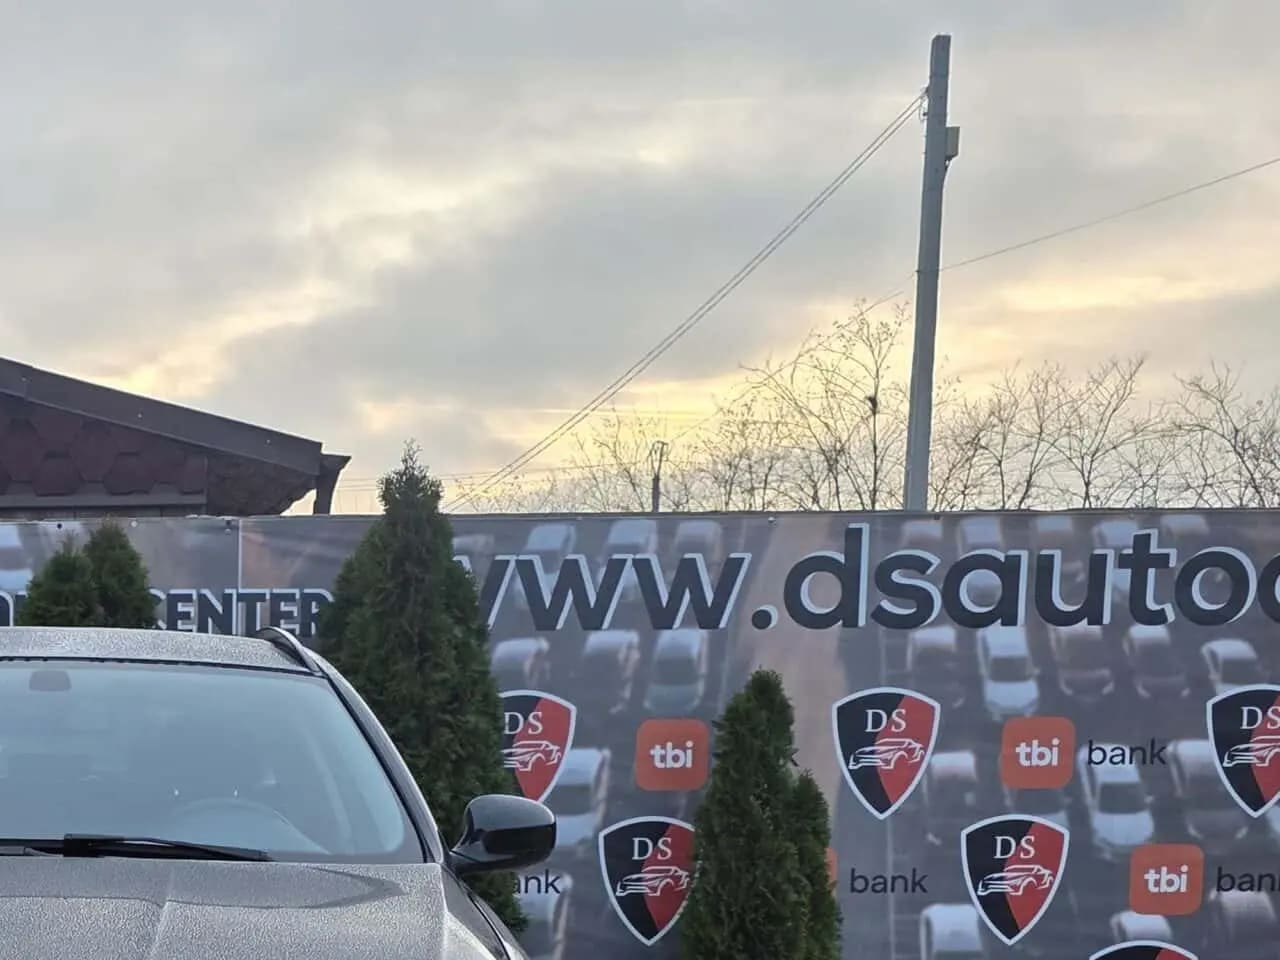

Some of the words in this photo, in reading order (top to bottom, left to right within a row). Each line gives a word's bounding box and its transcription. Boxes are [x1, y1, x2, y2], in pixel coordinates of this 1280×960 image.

[452, 522, 1280, 632] ww.dsauto
[503, 711, 544, 735] DS
[865, 708, 907, 733] DS
[1239, 706, 1280, 730] DS
[650, 740, 694, 769] tbi
[1016, 737, 1060, 767] tbi
[1087, 739, 1167, 767] bank
[632, 837, 673, 861] DS
[994, 835, 1036, 860] DS
[849, 868, 928, 895] bank
[1144, 864, 1188, 894] tbi
[1215, 866, 1280, 894] ban
